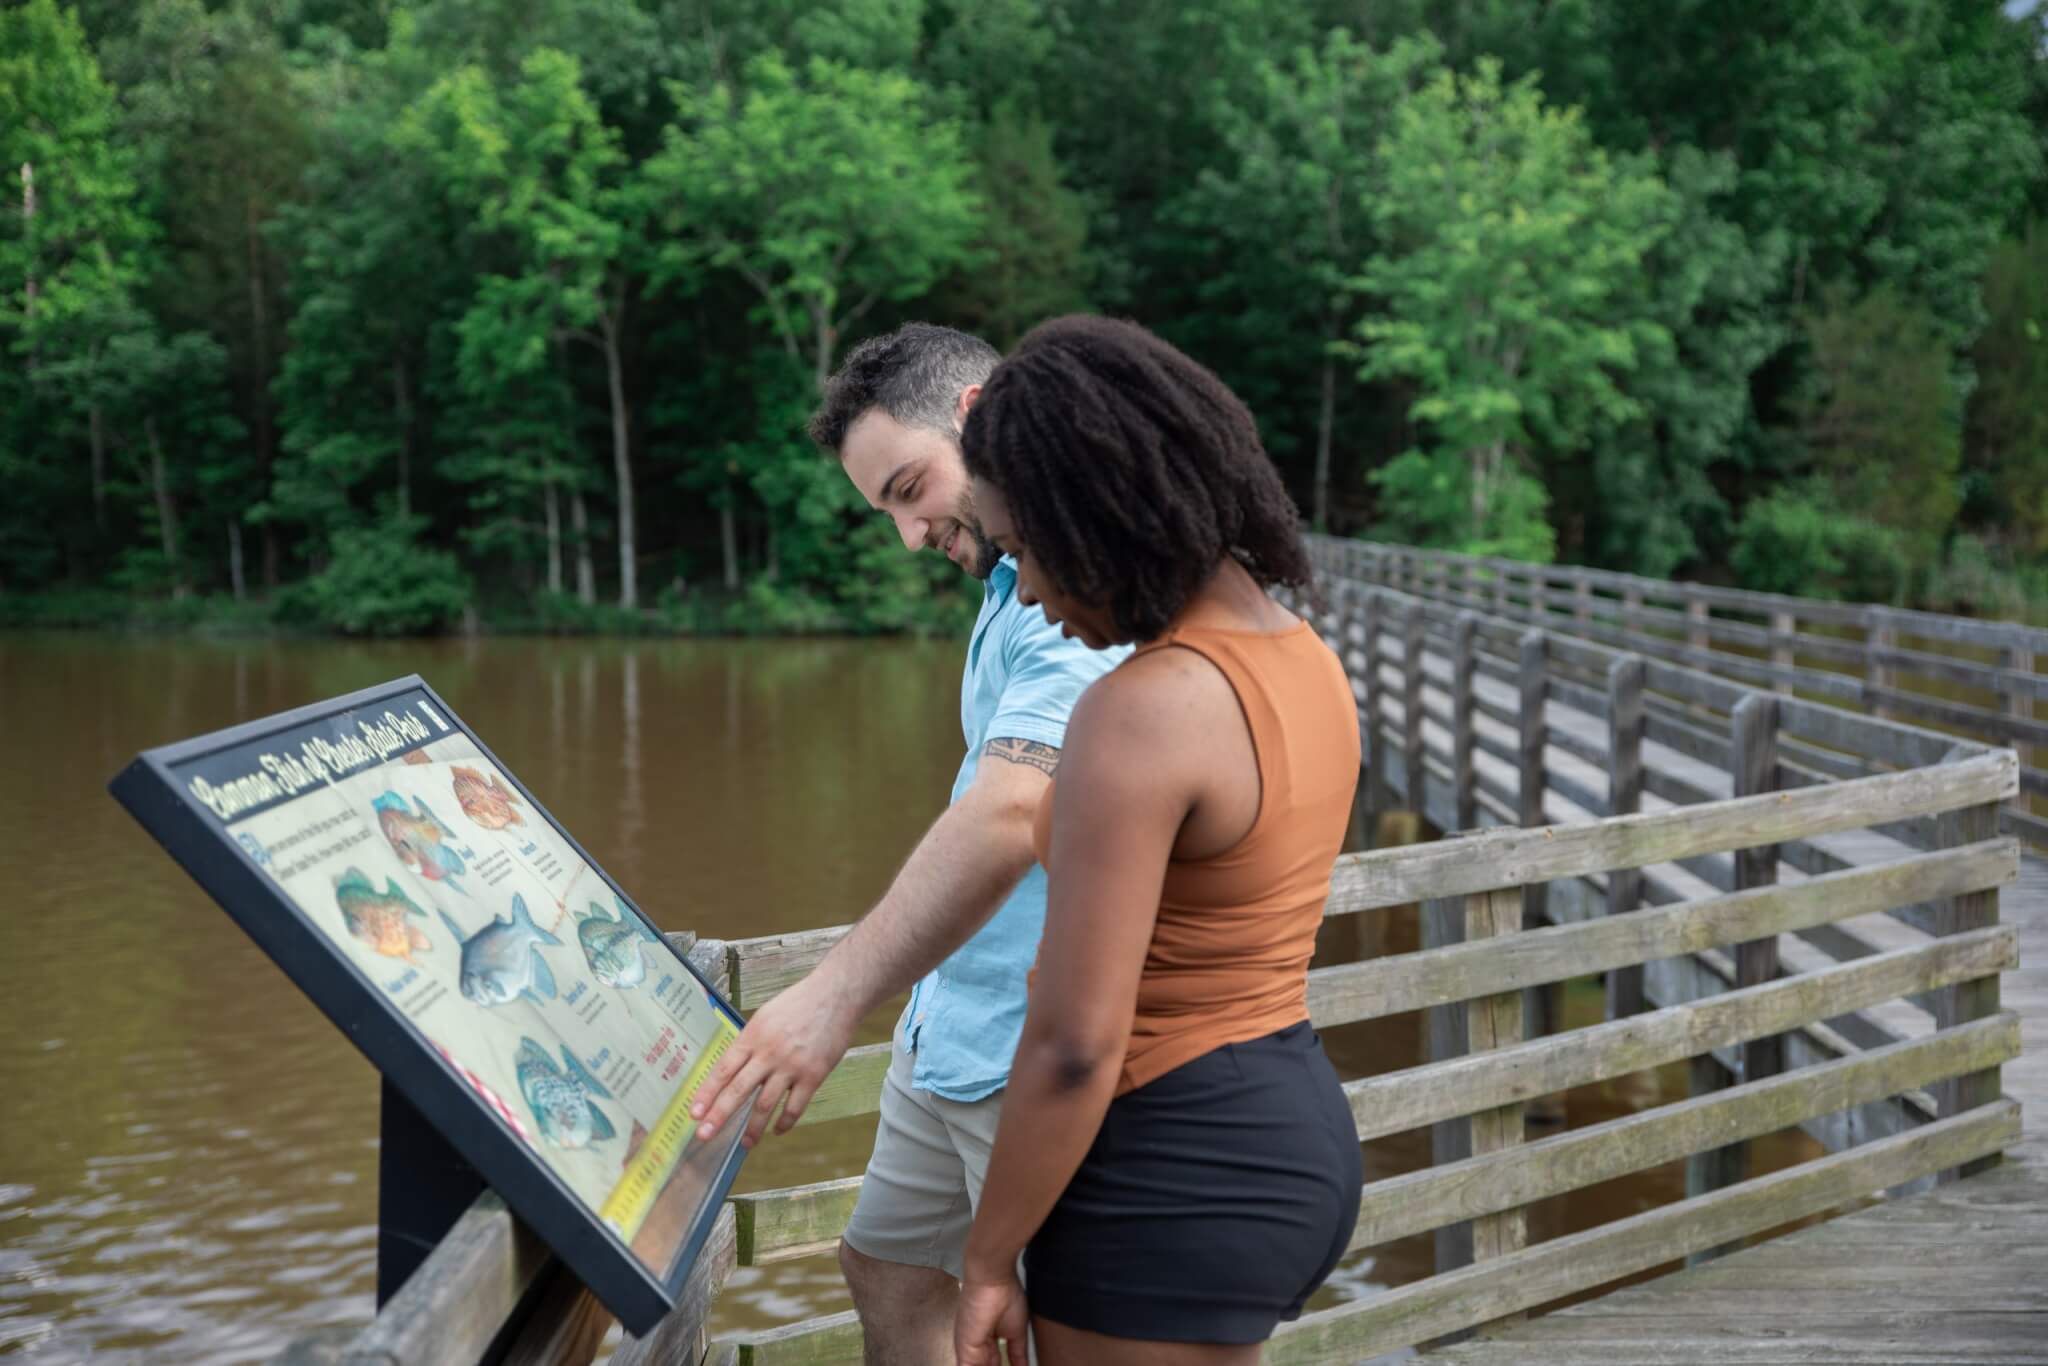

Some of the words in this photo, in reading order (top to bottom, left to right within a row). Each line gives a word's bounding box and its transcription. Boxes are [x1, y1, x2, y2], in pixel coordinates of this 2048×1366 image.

[259, 752, 315, 794] Fish
[302, 742, 334, 786] of
[358, 720, 404, 760] State
[384, 710, 430, 743] Park
